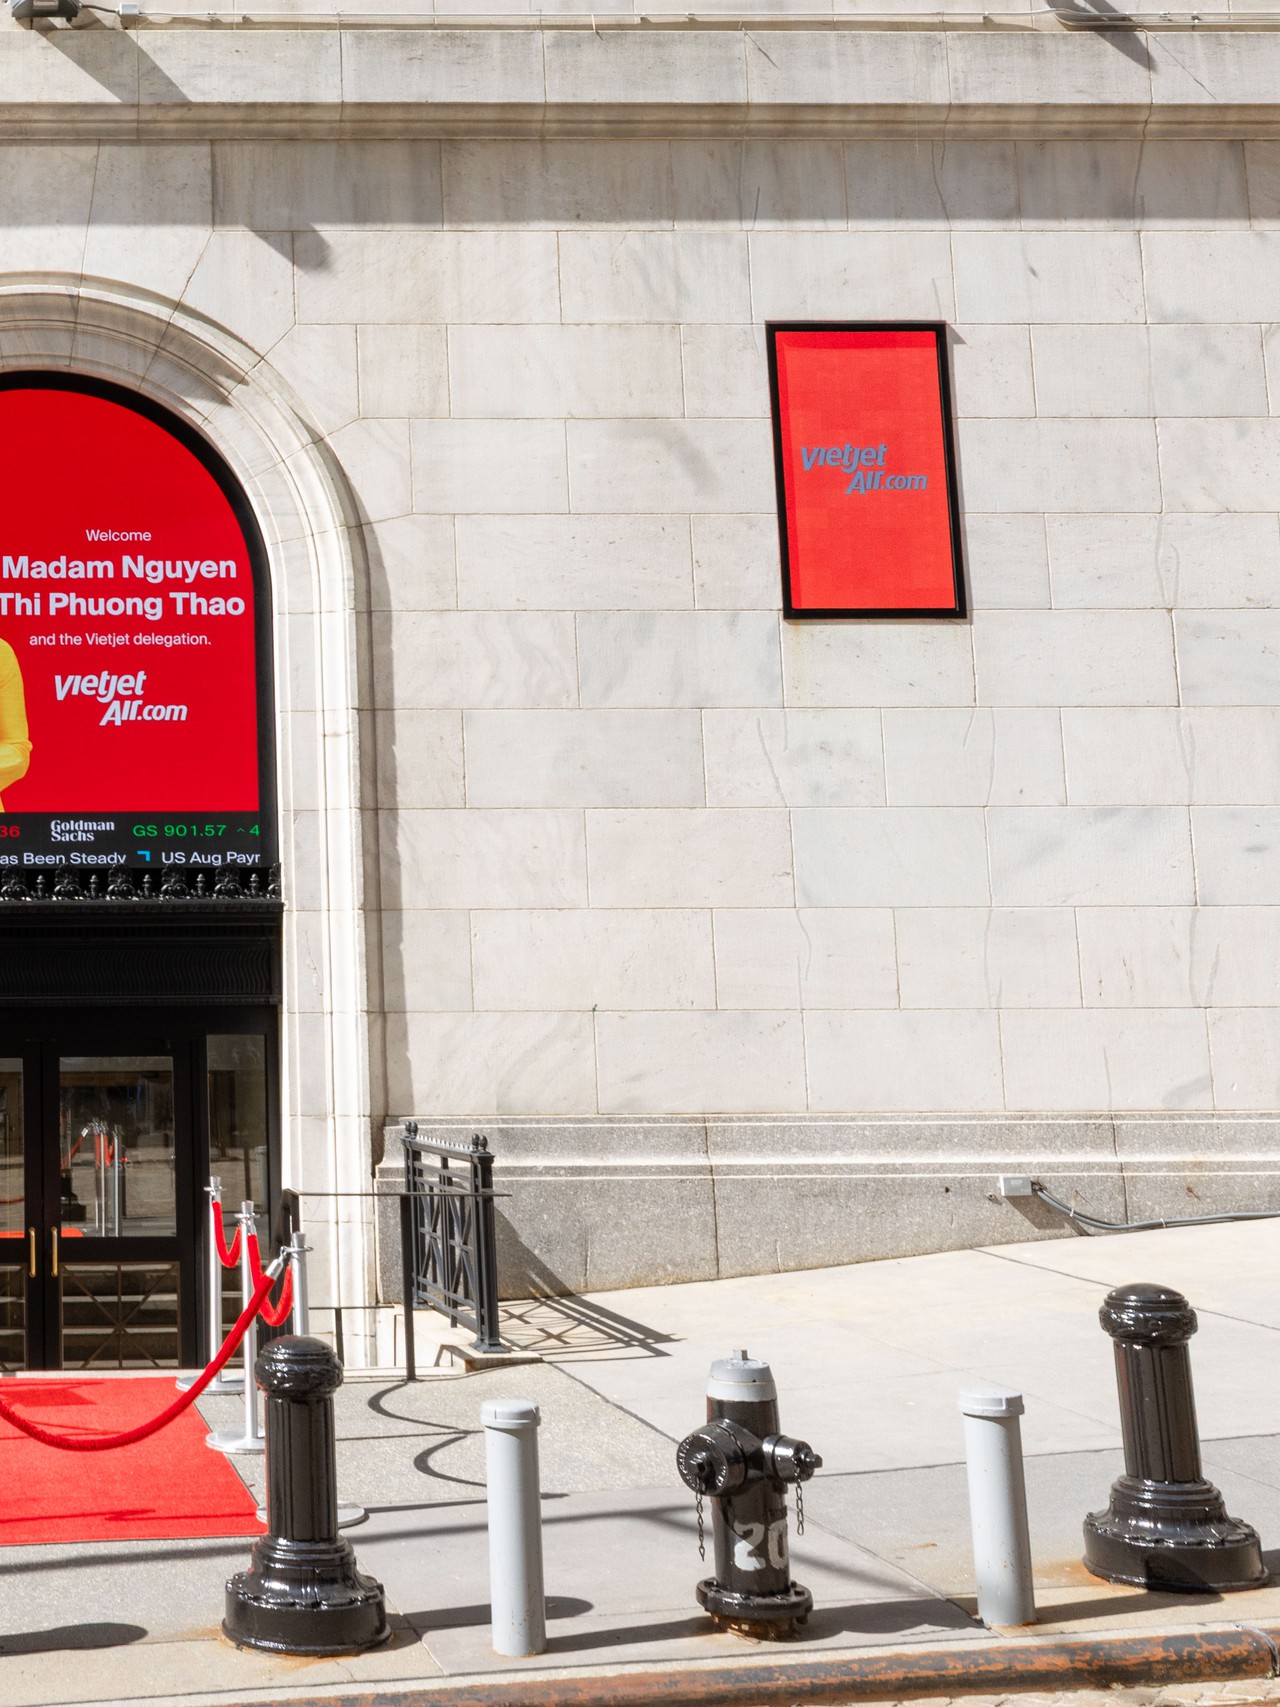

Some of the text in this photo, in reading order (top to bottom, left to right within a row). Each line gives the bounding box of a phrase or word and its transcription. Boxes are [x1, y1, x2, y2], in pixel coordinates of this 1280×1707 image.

[85, 529, 152, 542] Welcome
[2, 555, 237, 584] Madam Nguyen
[49, 592, 163, 621] Phuong
[169, 591, 246, 616] Thao
[29, 632, 212, 648] and the Vietjet delegation.
[50, 819, 115, 831] Goldman
[132, 824, 260, 837] GS 901.57 4
[51, 830, 95, 842] Sachs
[23, 852, 66, 865] Been
[161, 851, 261, 867] US Aug Payr
[733, 1519, 788, 1571] 20
